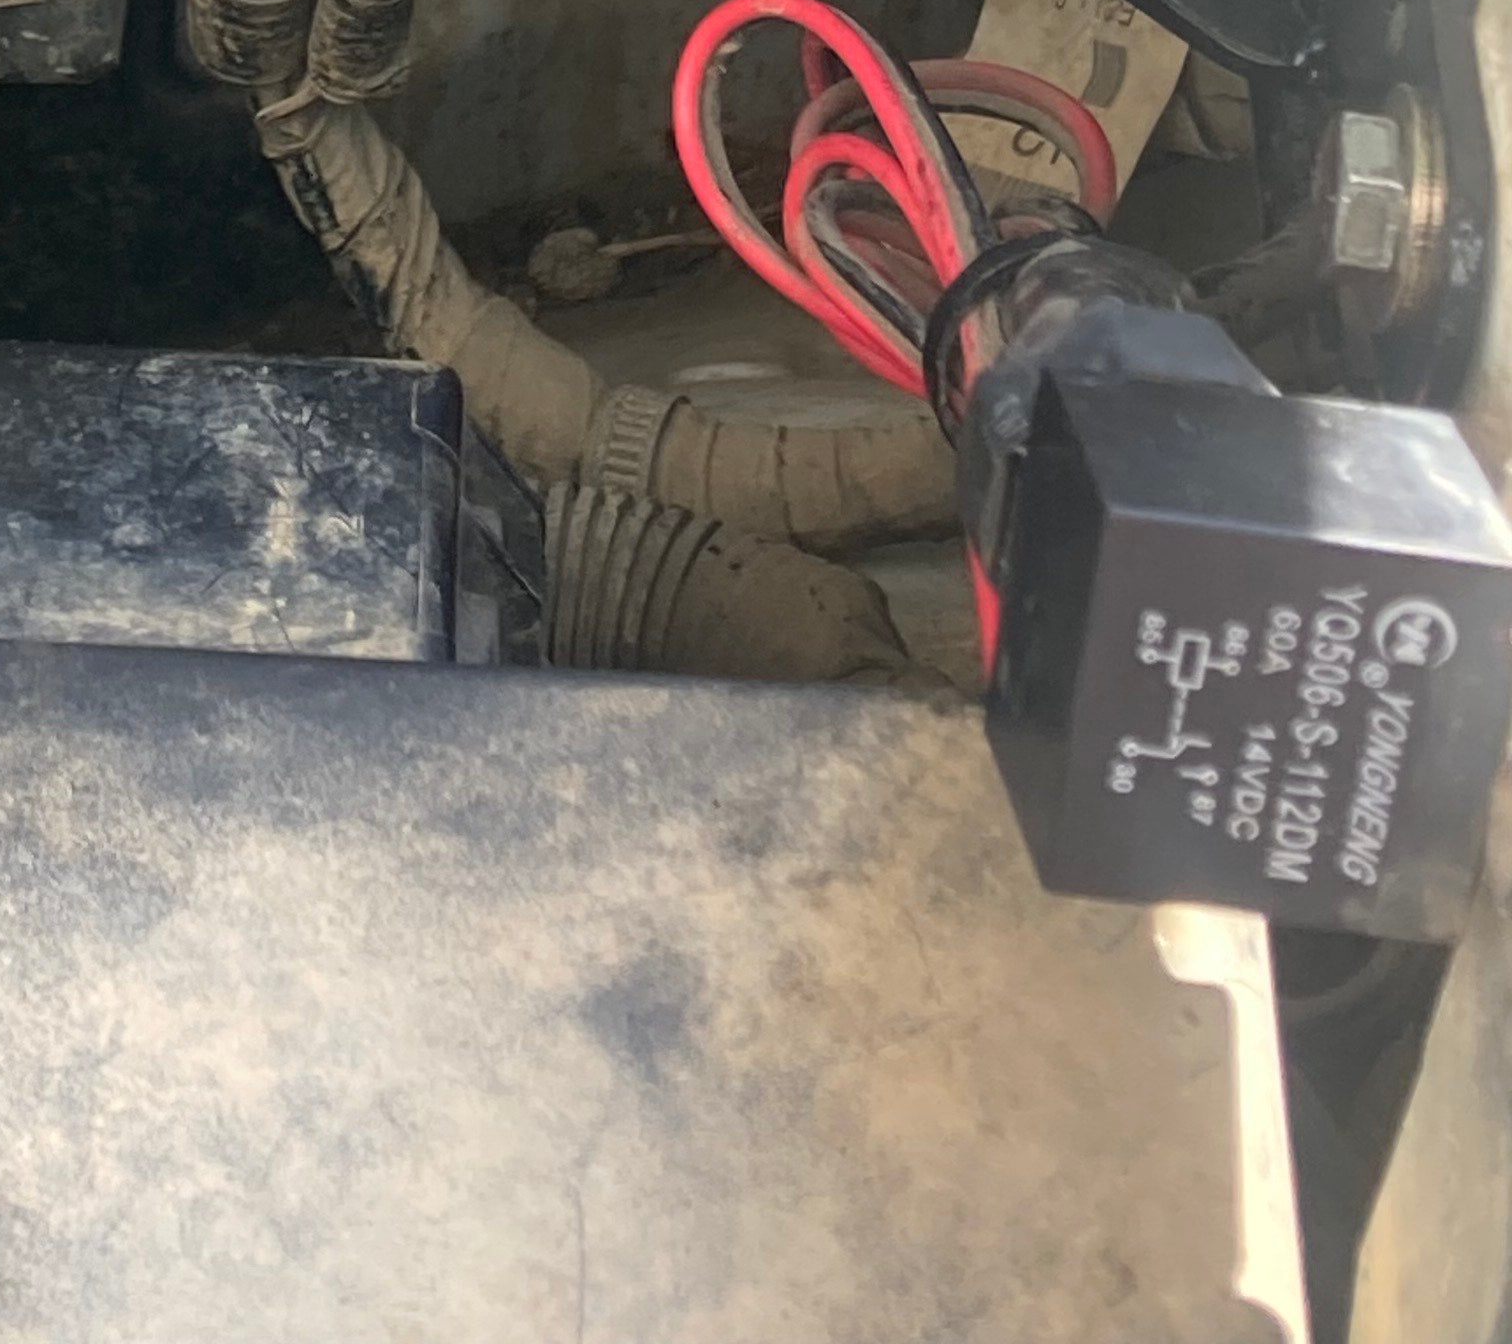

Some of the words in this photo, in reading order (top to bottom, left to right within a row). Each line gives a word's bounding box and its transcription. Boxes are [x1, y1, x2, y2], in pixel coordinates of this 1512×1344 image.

[1256, 606, 1303, 676] 60A
[1226, 722, 1277, 842] 14VDC
[1264, 583, 1370, 884] YQ506-S-112DM
[1340, 689, 1416, 887] YONGNENG
